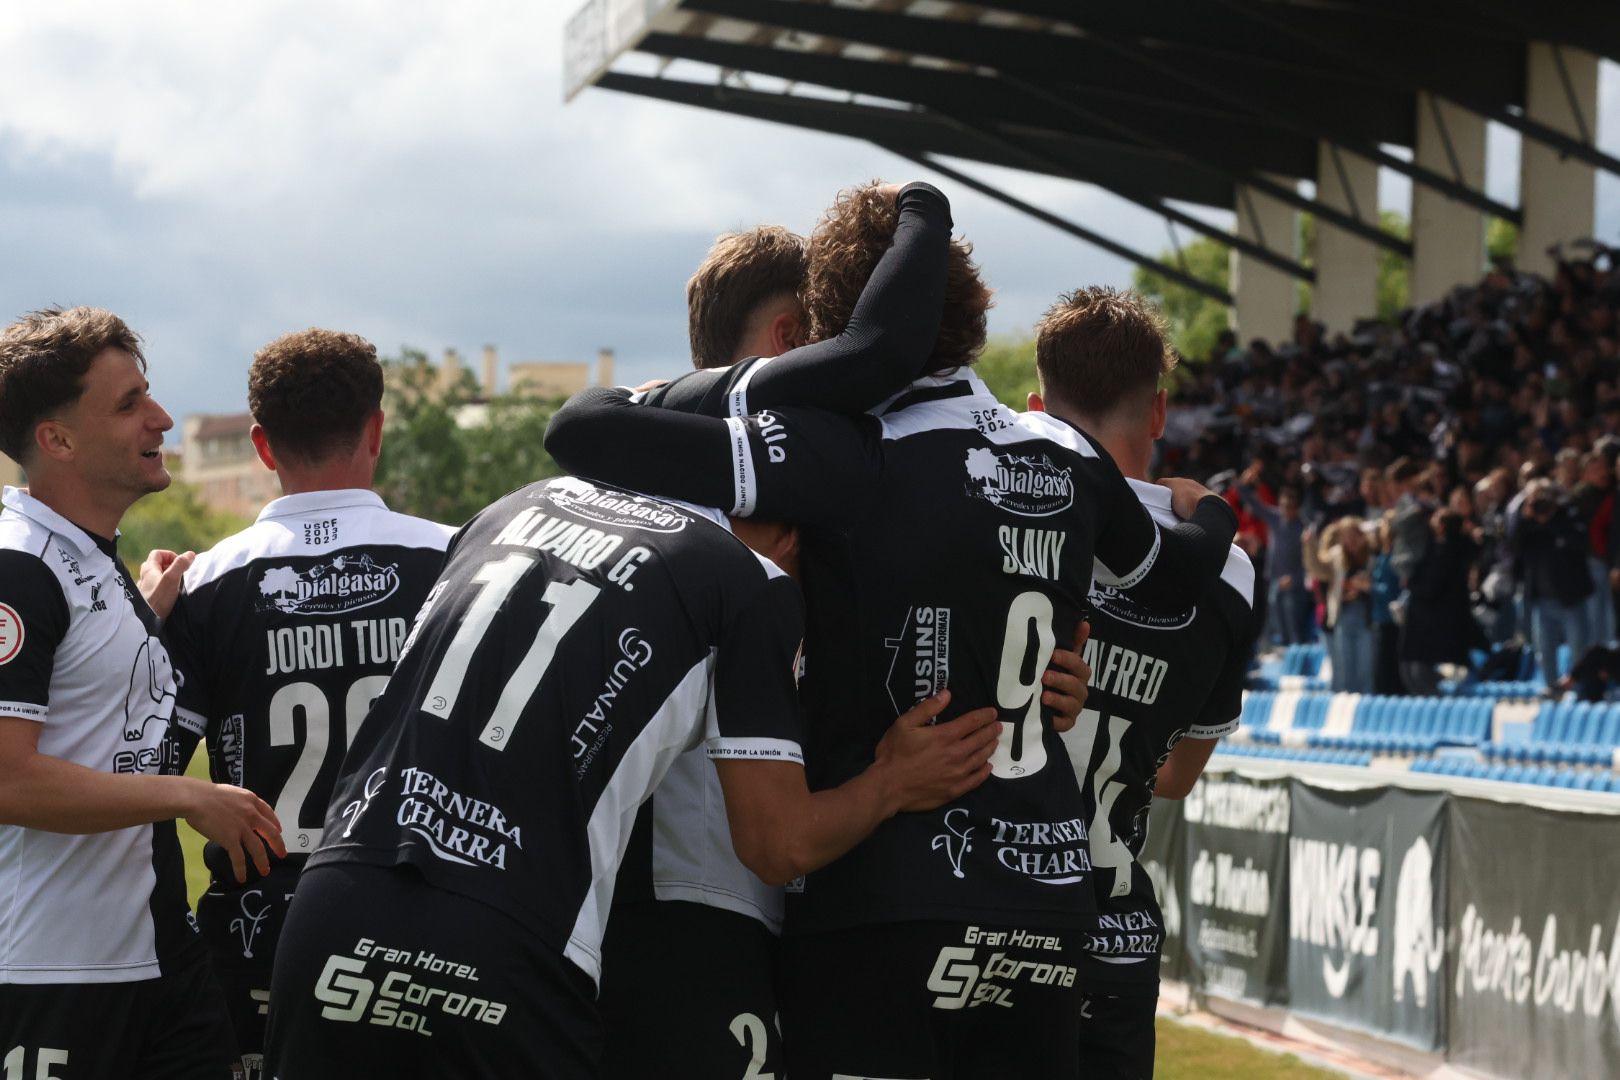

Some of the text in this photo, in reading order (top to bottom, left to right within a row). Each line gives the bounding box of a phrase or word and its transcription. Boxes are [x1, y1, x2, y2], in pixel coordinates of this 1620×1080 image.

[304, 518, 338, 530] USCF
[304, 527, 338, 537] 2013
[305, 533, 338, 545] 2023
[607, 545, 652, 592] G.
[999, 525, 1066, 581] SLAVY
[296, 572, 387, 601] Dialgasa
[266, 617, 407, 676] JORDI TUR
[421, 552, 602, 751] 11
[914, 606, 934, 699] USINS
[936, 610, 948, 659] REFORMAS
[571, 628, 653, 758] GUINALD
[988, 591, 1056, 779] 9
[1082, 638, 1169, 705] ALFRED
[397, 798, 507, 870] CHARRA
[400, 766, 523, 850] TERNERA
[353, 937, 412, 965] Gran
[965, 925, 1008, 946] Gran
[380, 970, 508, 1025] Corona
[981, 952, 1078, 988] Corona
[729, 1012, 783, 1080] 2
